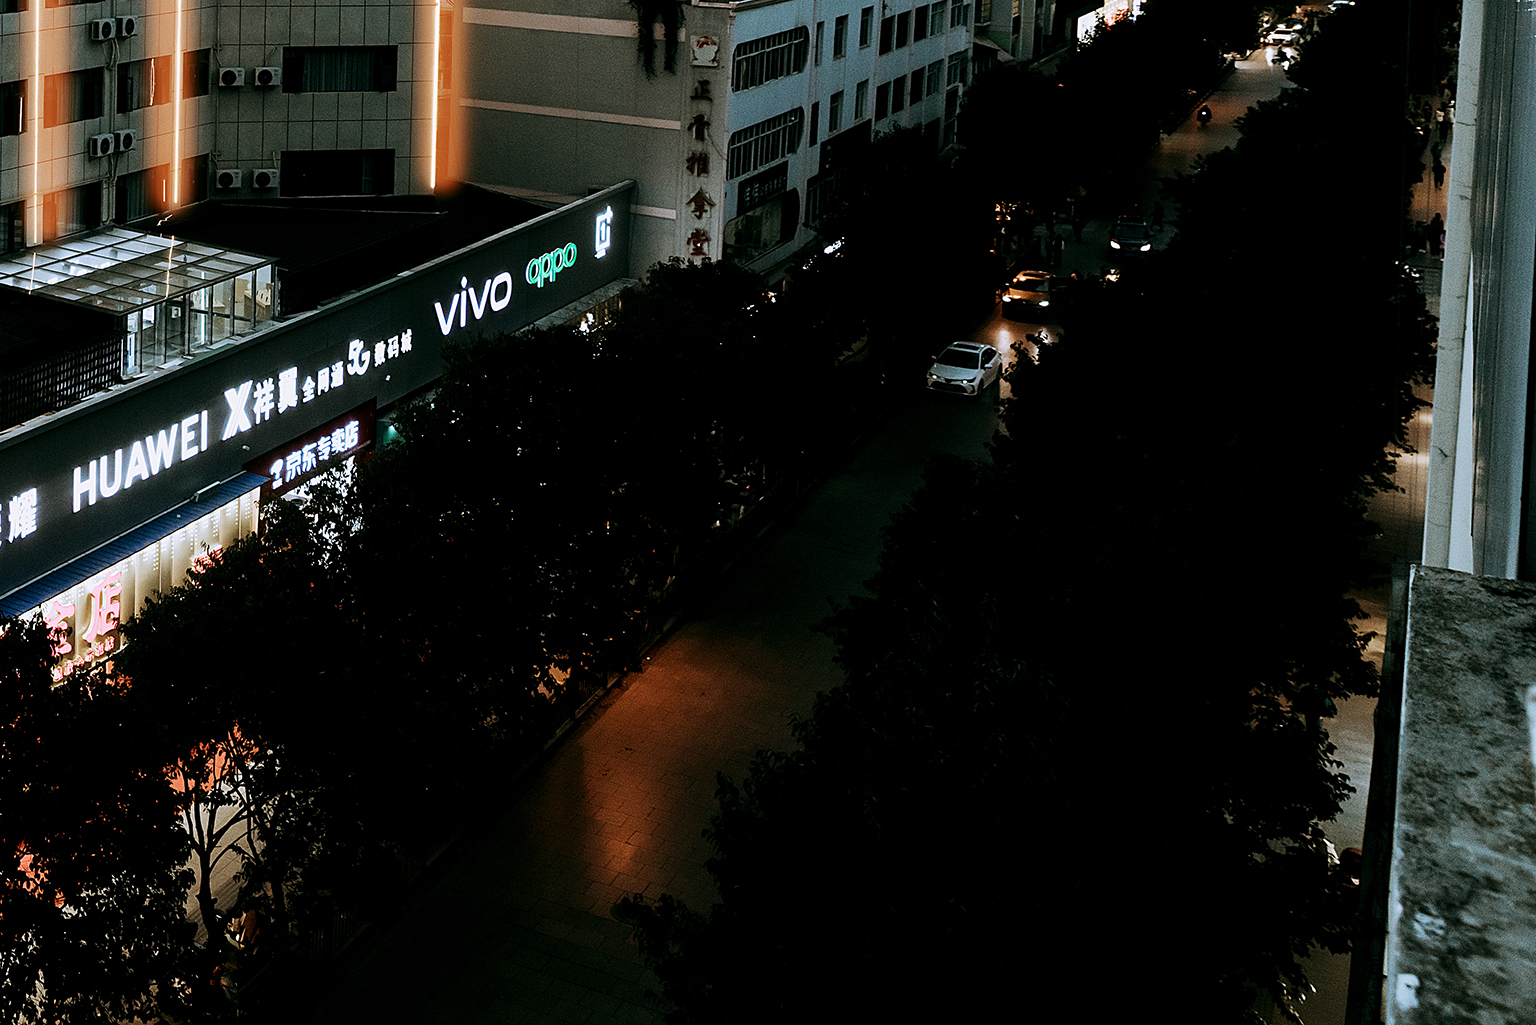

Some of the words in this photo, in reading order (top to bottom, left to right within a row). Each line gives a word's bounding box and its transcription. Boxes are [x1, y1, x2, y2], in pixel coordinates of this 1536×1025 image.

[685, 79, 716, 257] 正骨推拿堂
[434, 271, 512, 336] vivo
[72, 410, 209, 514] HUAWEI
[285, 419, 360, 483] 京东专卖店
